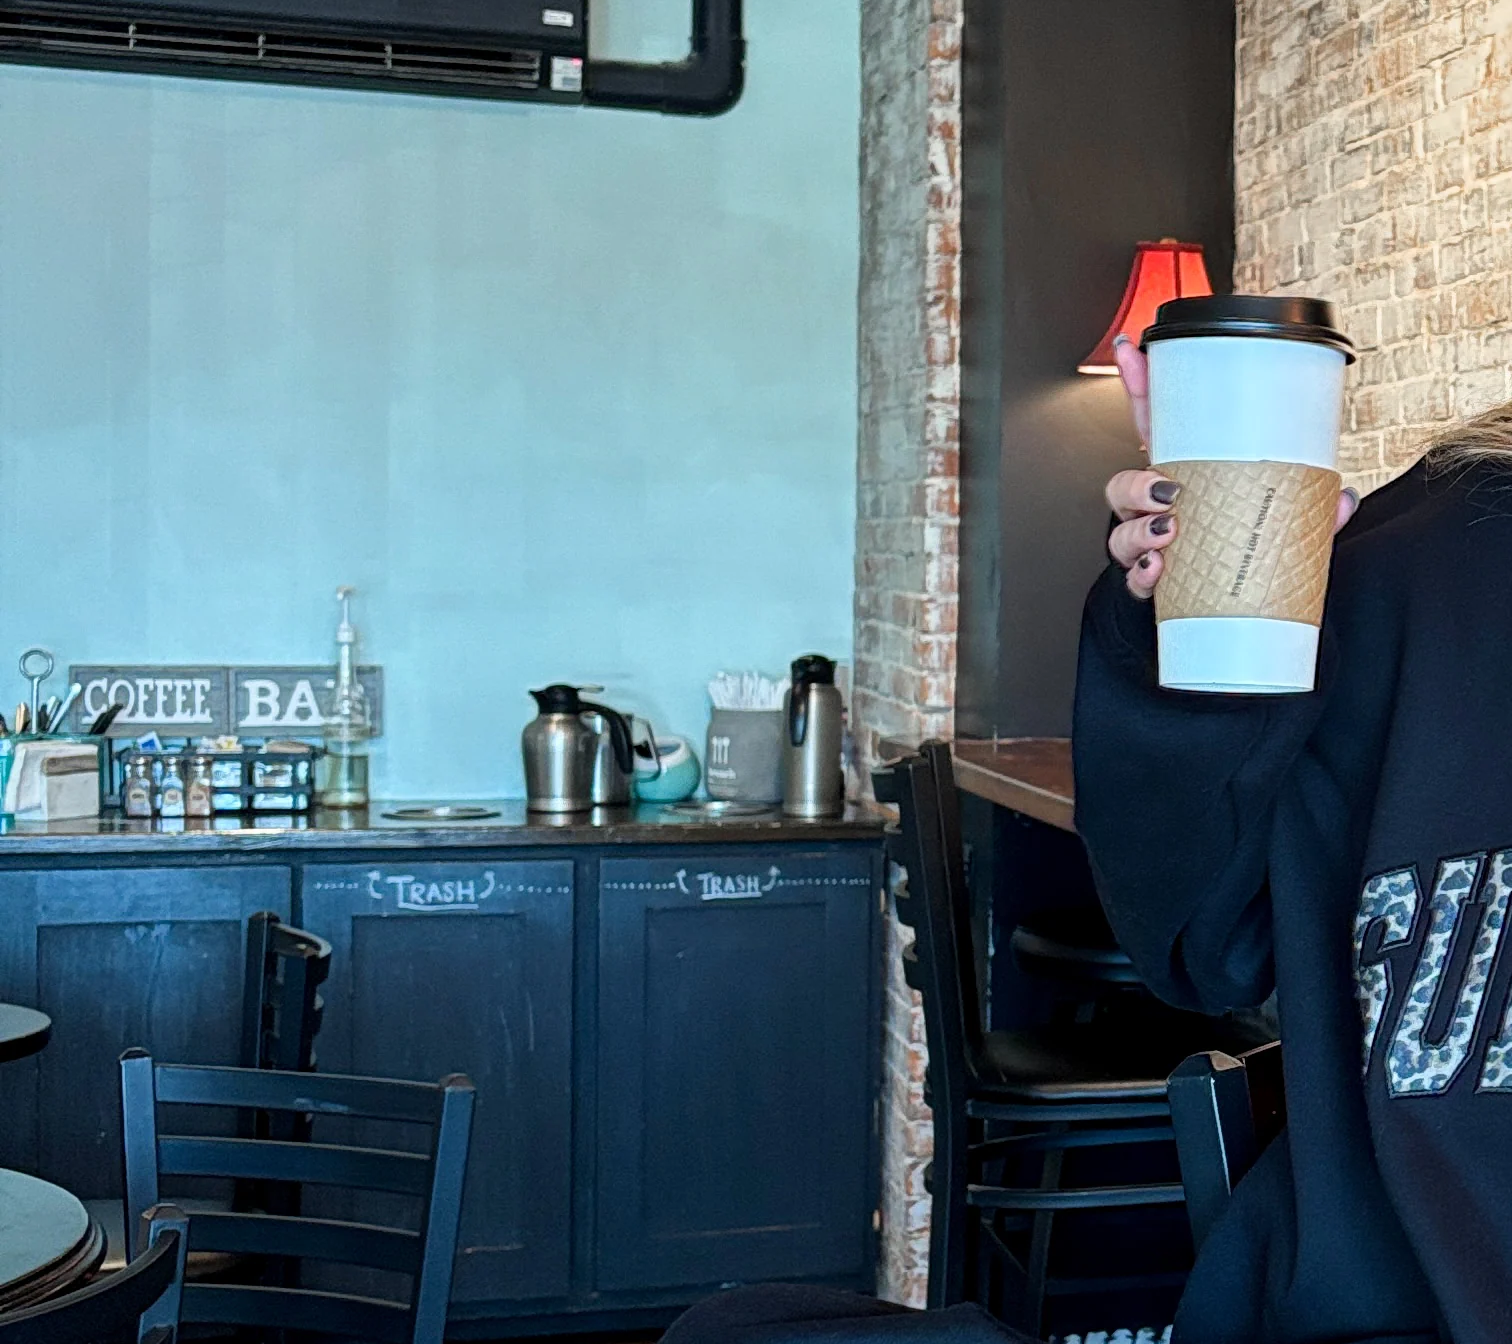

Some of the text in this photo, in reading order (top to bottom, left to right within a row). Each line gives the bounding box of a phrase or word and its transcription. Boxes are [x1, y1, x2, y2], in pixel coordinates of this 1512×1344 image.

[81, 677, 371, 727] COFFEE BA
[387, 874, 477, 905] TRASH
[698, 872, 762, 894] TRASH
